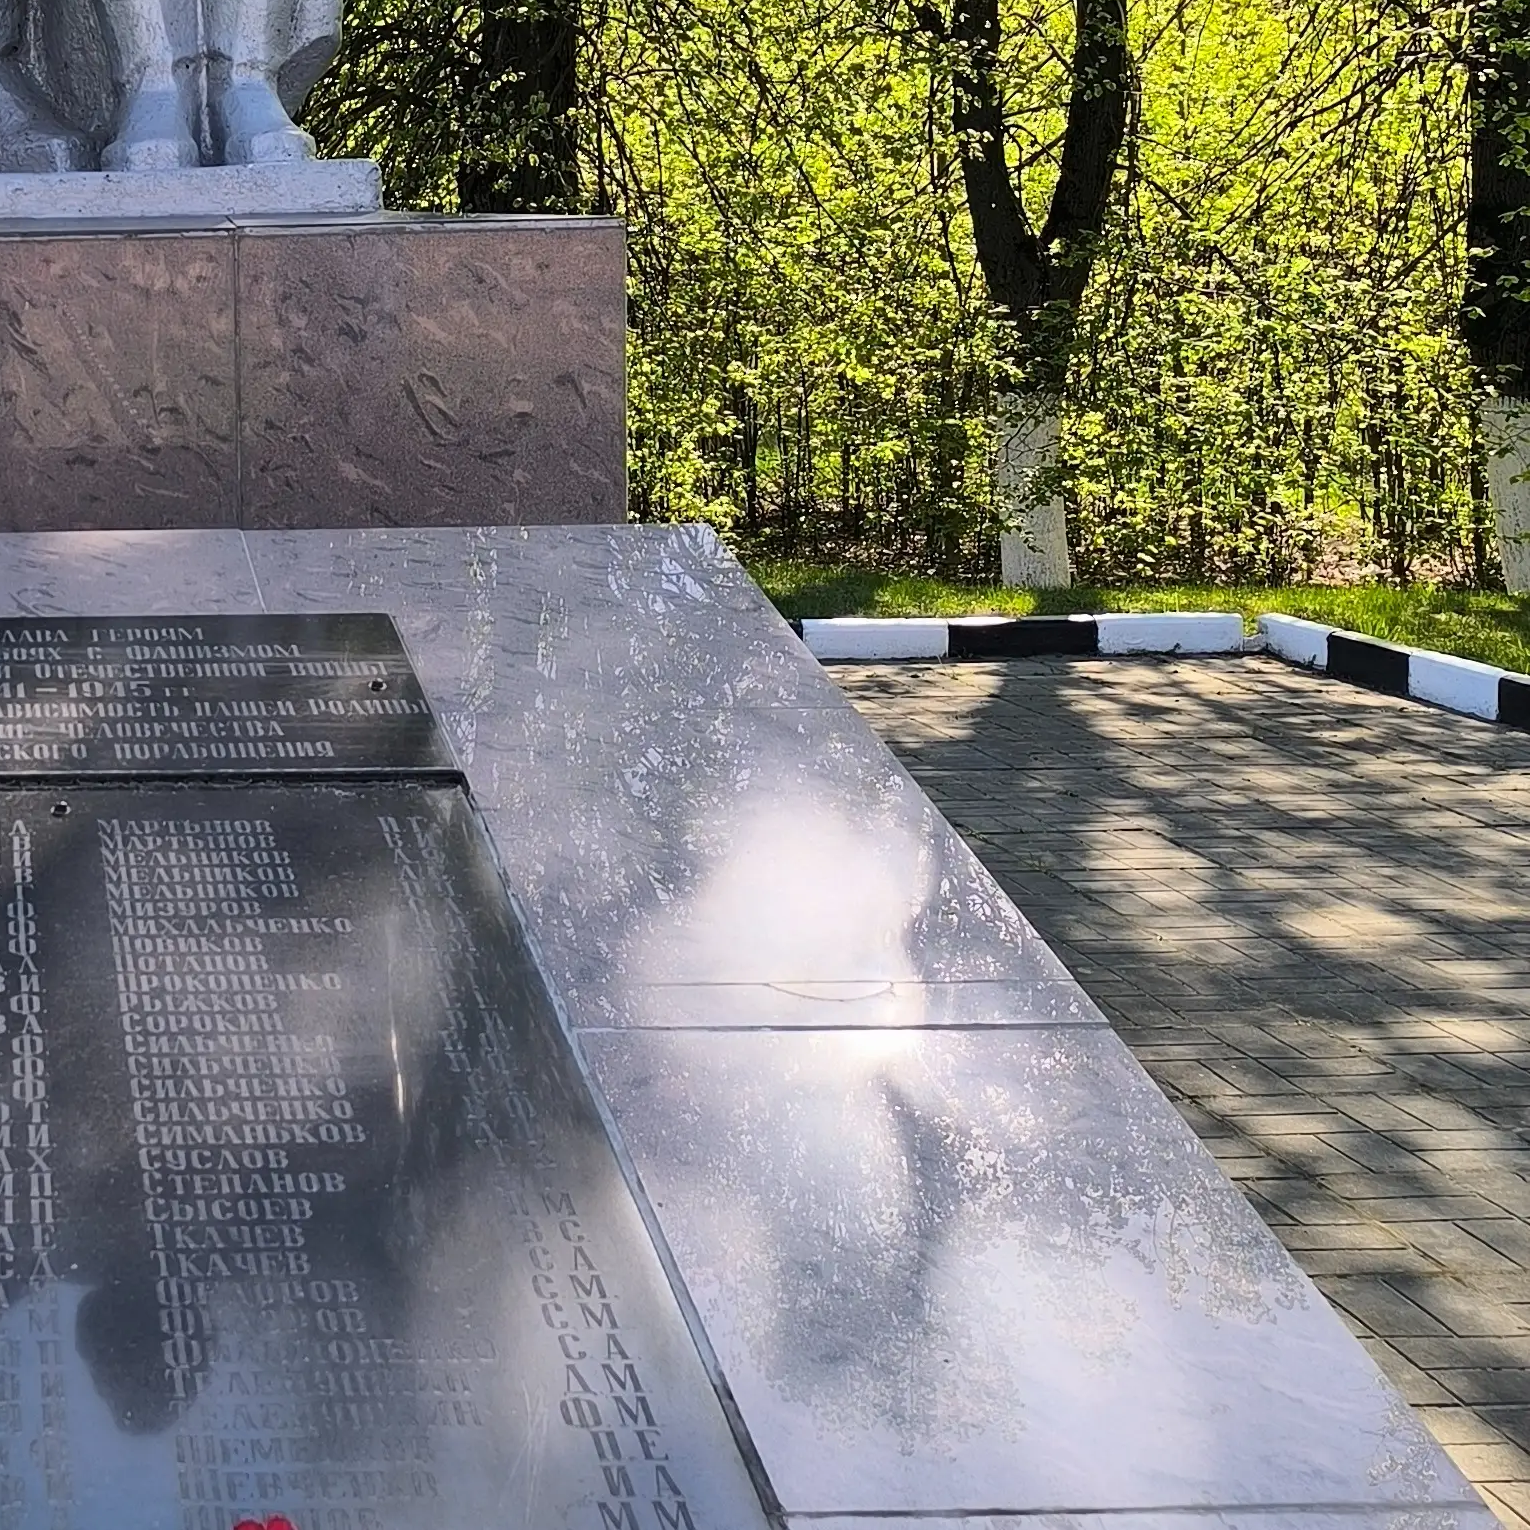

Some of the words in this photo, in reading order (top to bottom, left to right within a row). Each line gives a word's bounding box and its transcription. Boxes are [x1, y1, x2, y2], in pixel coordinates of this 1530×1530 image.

[90, 627, 205, 643] ГЕРОЯМ
[86, 645, 103, 660] С
[125, 643, 303, 660] ФАШИЗМОМ
[34, 662, 266, 680] ОТЕЧЕСТВЕННОЙ
[193, 699, 298, 717] НАШЕЙ
[307, 698, 430, 716] РОДИНЫ
[57, 721, 286, 740] ЧЕЛОВЕЧЕСТВА
[114, 740, 337, 762] ПОРАБОЩЕНИЯ
[97, 819, 274, 835] МАРТЫНОВ
[98, 833, 277, 851] МАРТЫНОВ
[100, 848, 292, 866] МЕЛЬНИКОВ
[103, 866, 296, 883] МЕЛЬНИКОВ
[106, 883, 300, 900] МЕЛЬНИКОВ
[108, 900, 262, 918] МИЗУРОВ
[109, 917, 353, 936] МИХАЛЬЧЕНКО
[112, 935, 264, 954] НОВИКОВ
[113, 953, 269, 973] ПОТАПОВ
[116, 972, 342, 992] ПРОКОПЕНКО
[118, 992, 278, 1013] РЫЖКОВ
[122, 1012, 284, 1034] СОРОКИН
[127, 1054, 342, 1076] СИЛЬЧЕНКО
[130, 1076, 348, 1099] СИЛЬЧЕНКО
[133, 1099, 356, 1123] СИЛЬЧЕНКО
[135, 1122, 368, 1146] СИМАНЬКОВ
[138, 1146, 290, 1171] СУСЛОВ
[142, 1170, 347, 1196] СТЕПАНОВ
[144, 1196, 314, 1222] СЫСОЕВ
[146, 1222, 306, 1249] ТКАЧЕВ
[149, 1249, 313, 1278] ТКАЧЕВ
